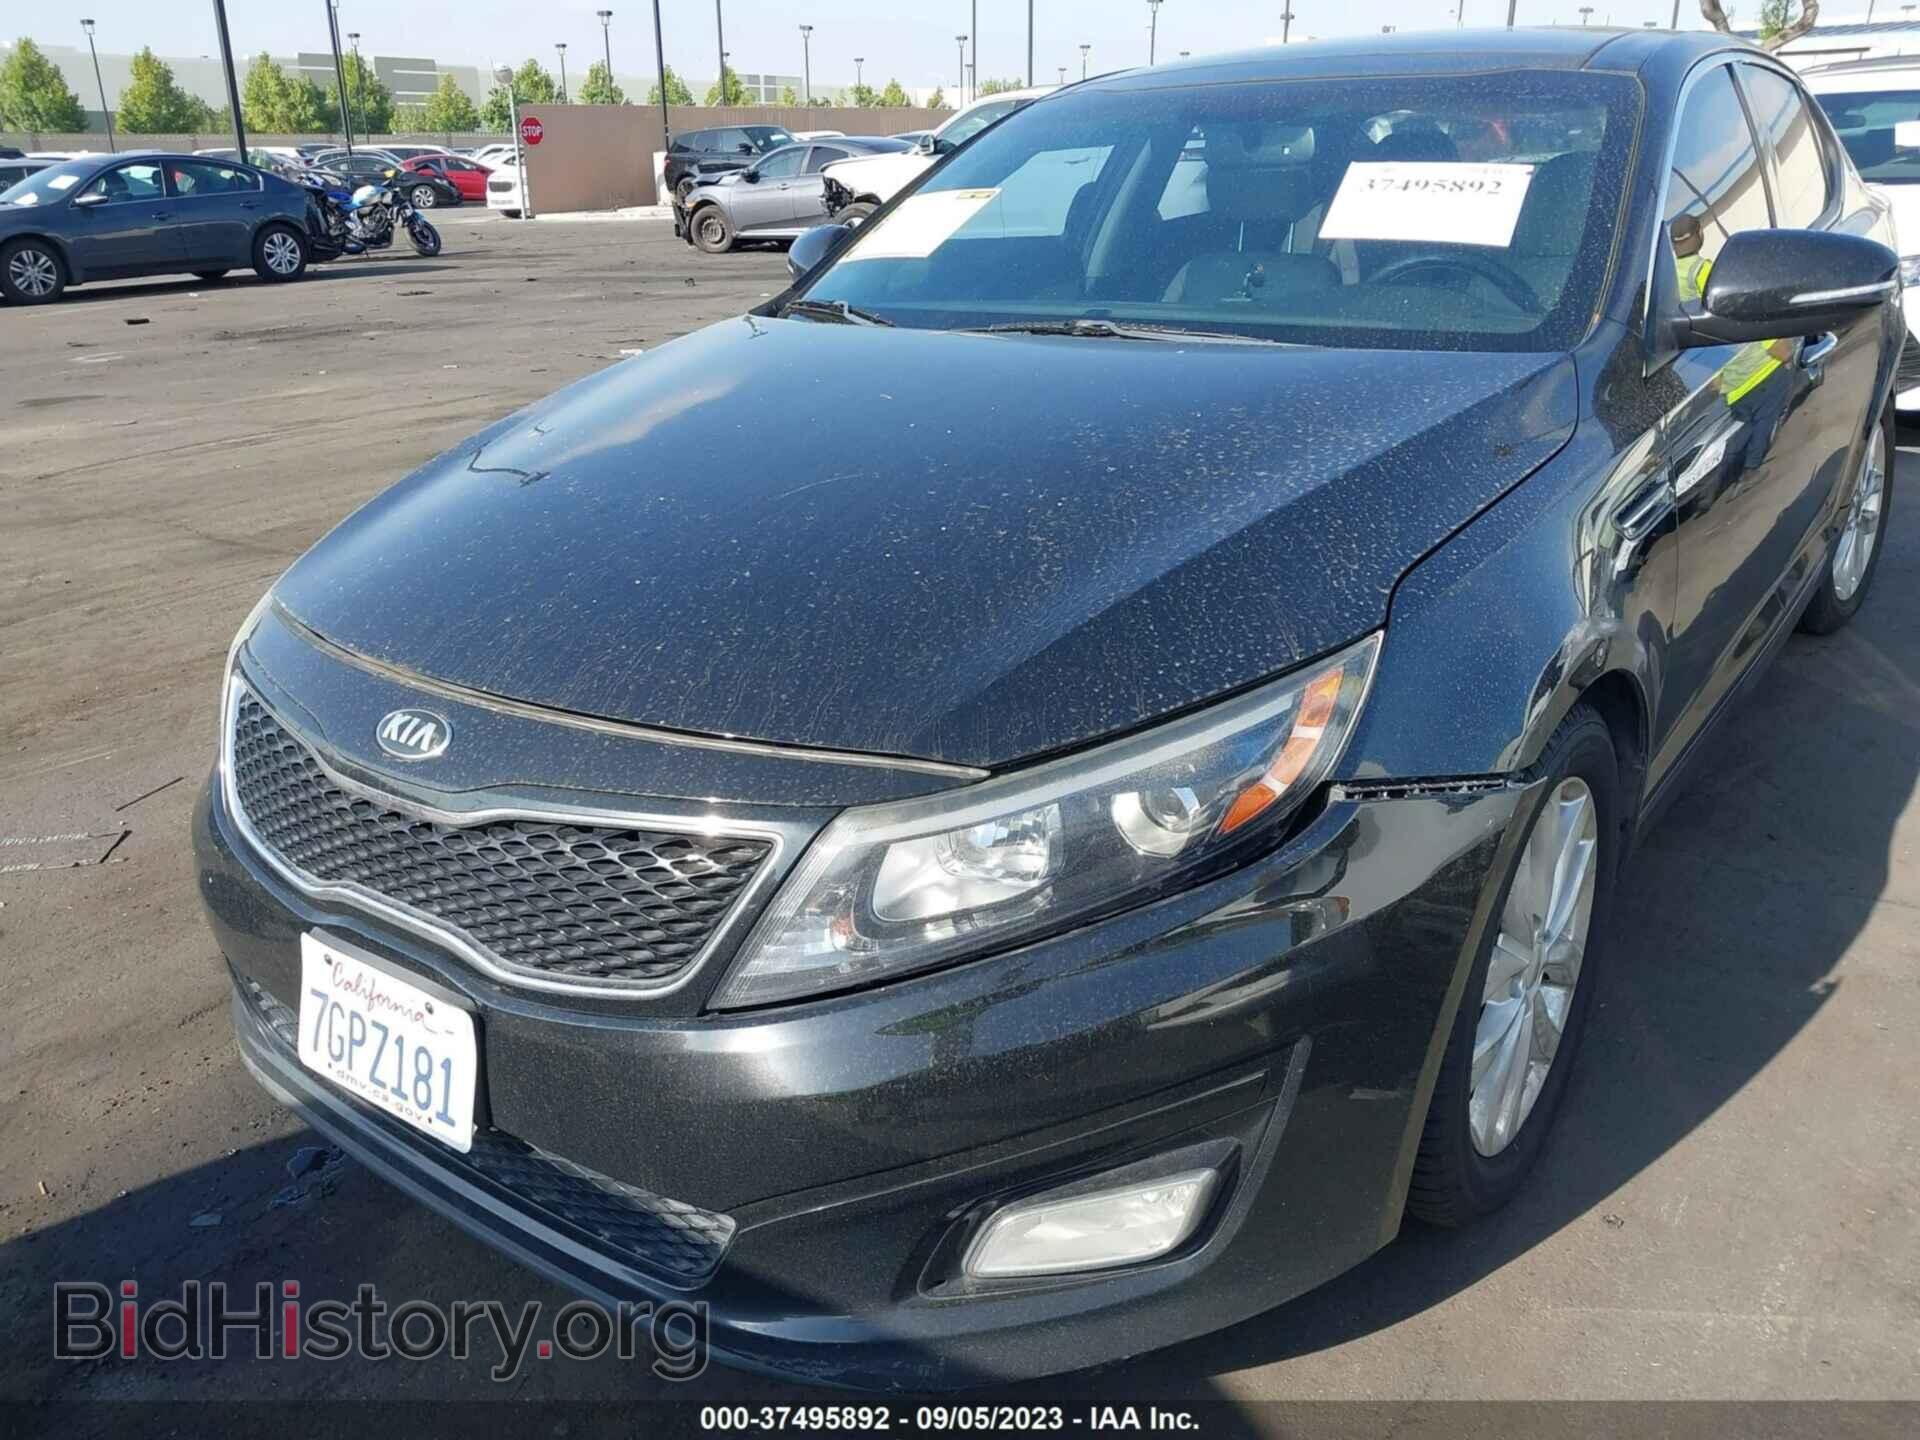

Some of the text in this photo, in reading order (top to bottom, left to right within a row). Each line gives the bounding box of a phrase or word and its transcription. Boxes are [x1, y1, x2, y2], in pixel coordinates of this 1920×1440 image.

[522, 125, 542, 137] STOP
[1360, 178, 1502, 195] 37495892
[382, 713, 437, 752] KIA
[332, 961, 437, 1034] California
[311, 988, 456, 1128] 7GPZ181
